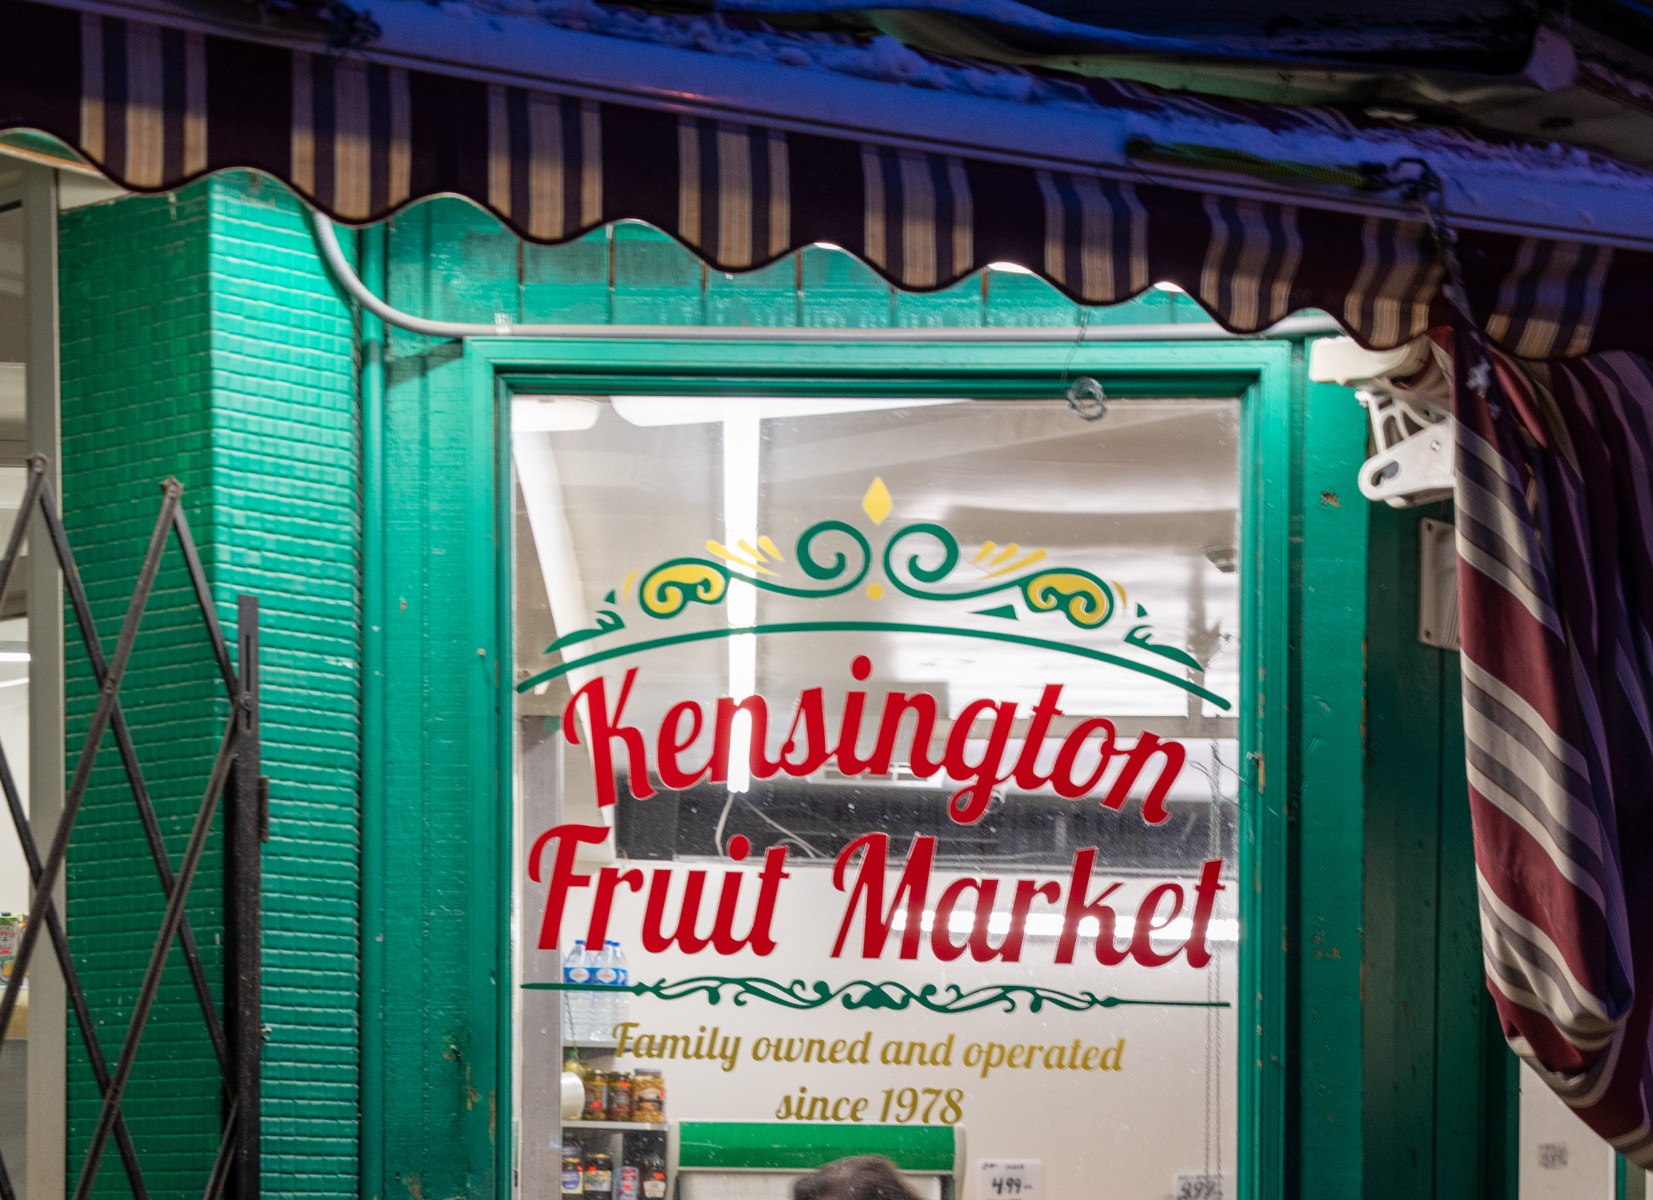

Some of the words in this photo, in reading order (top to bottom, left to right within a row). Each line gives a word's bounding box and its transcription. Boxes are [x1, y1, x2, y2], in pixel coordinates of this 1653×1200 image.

[562, 655, 1186, 824] Kensington
[528, 824, 789, 956] Fruit
[832, 833, 1224, 968] Market
[612, 1022, 741, 1072] Family
[752, 1032, 871, 1064] owned
[880, 1034, 954, 1066] and
[963, 1039, 1124, 1078] operated
[776, 1087, 867, 1121] since
[880, 1087, 964, 1123] 1978
